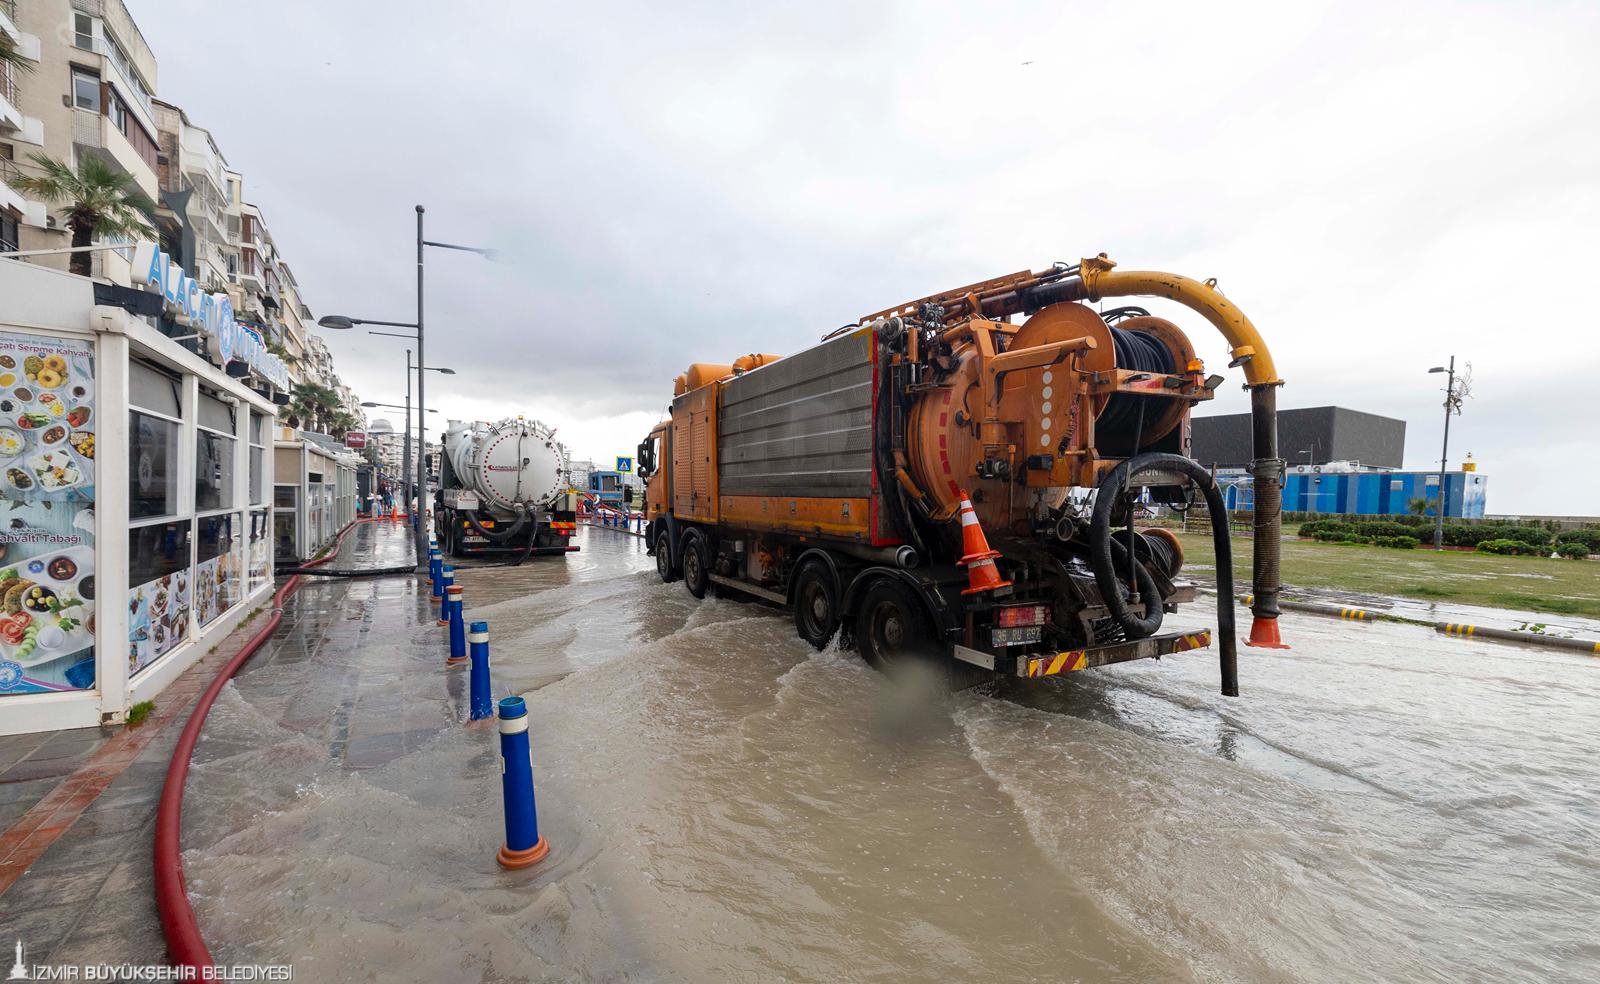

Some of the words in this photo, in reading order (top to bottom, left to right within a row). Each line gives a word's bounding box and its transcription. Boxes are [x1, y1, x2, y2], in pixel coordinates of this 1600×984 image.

[17, 343, 54, 354] Serpme
[56, 347, 92, 358] Kahvaltı
[42, 534, 82, 544] Tabağı
